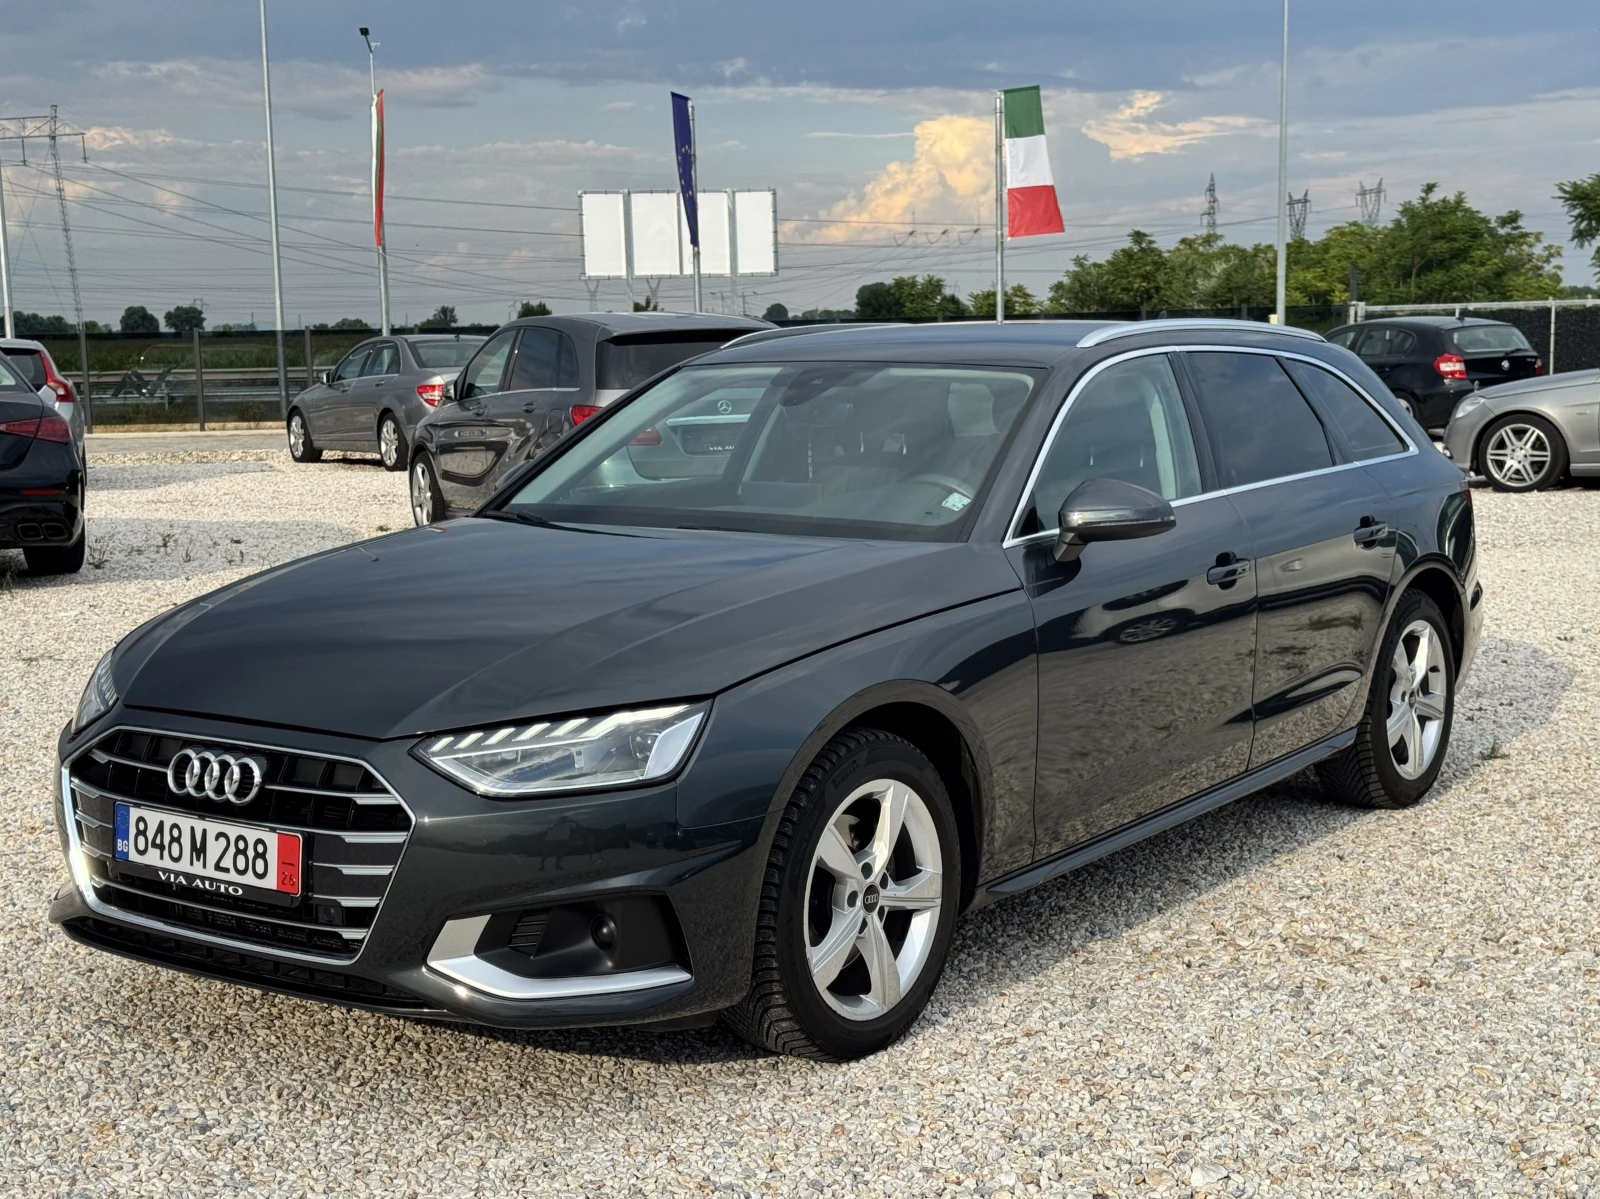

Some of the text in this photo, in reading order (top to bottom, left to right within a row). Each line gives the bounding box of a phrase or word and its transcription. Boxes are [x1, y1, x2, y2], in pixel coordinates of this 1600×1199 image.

[831, 759, 860, 789] PIRELLI
[117, 838, 129, 853] BG
[133, 815, 269, 880] 848 M 288
[157, 870, 244, 897] VIA AUTO
